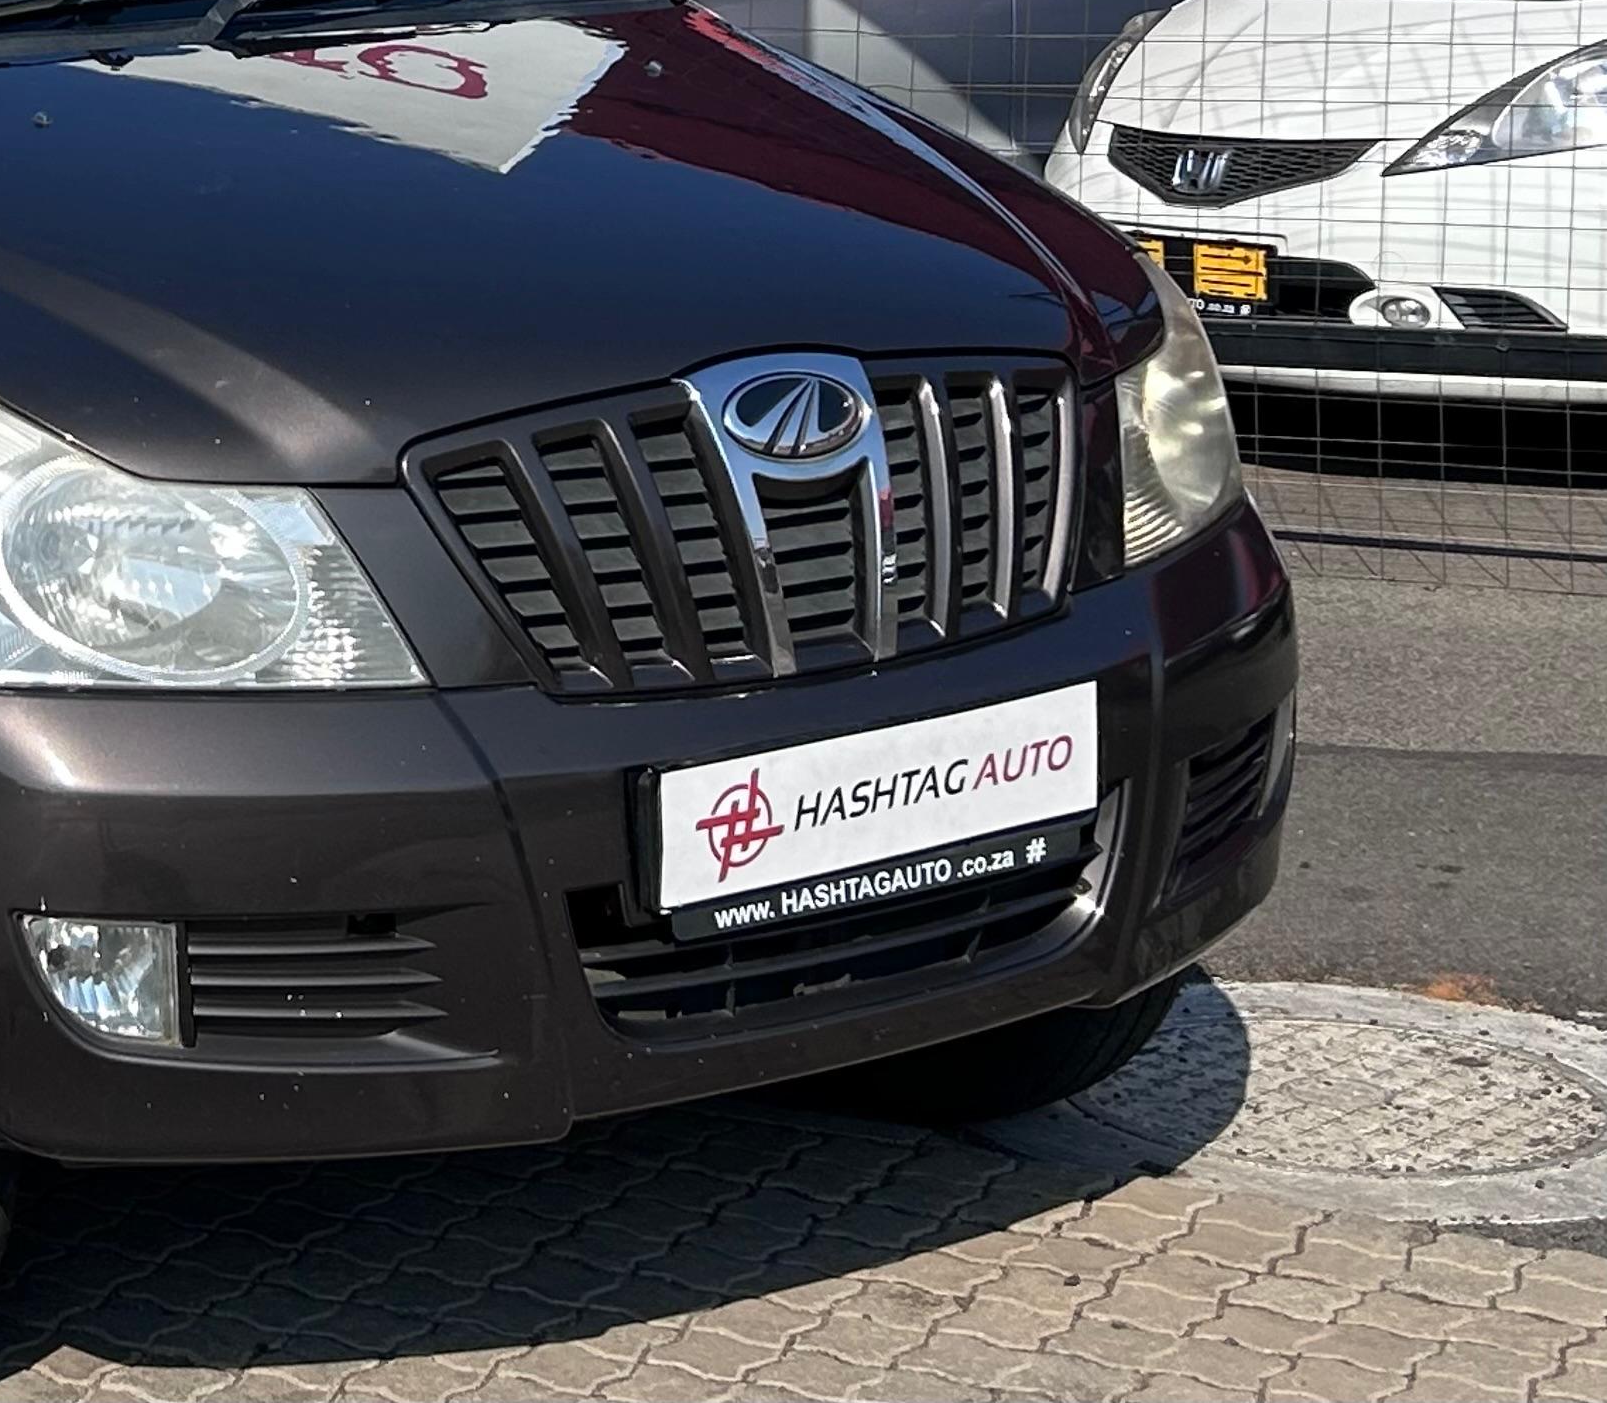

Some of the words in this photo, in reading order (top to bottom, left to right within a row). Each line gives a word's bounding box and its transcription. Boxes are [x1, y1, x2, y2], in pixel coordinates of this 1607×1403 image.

[793, 758, 969, 832] HASHTAG
[971, 734, 1074, 792] AUTO
[714, 900, 776, 929] www.
[780, 856, 952, 917] HASHTAGAUTO
[956, 850, 1015, 879] .co.za
